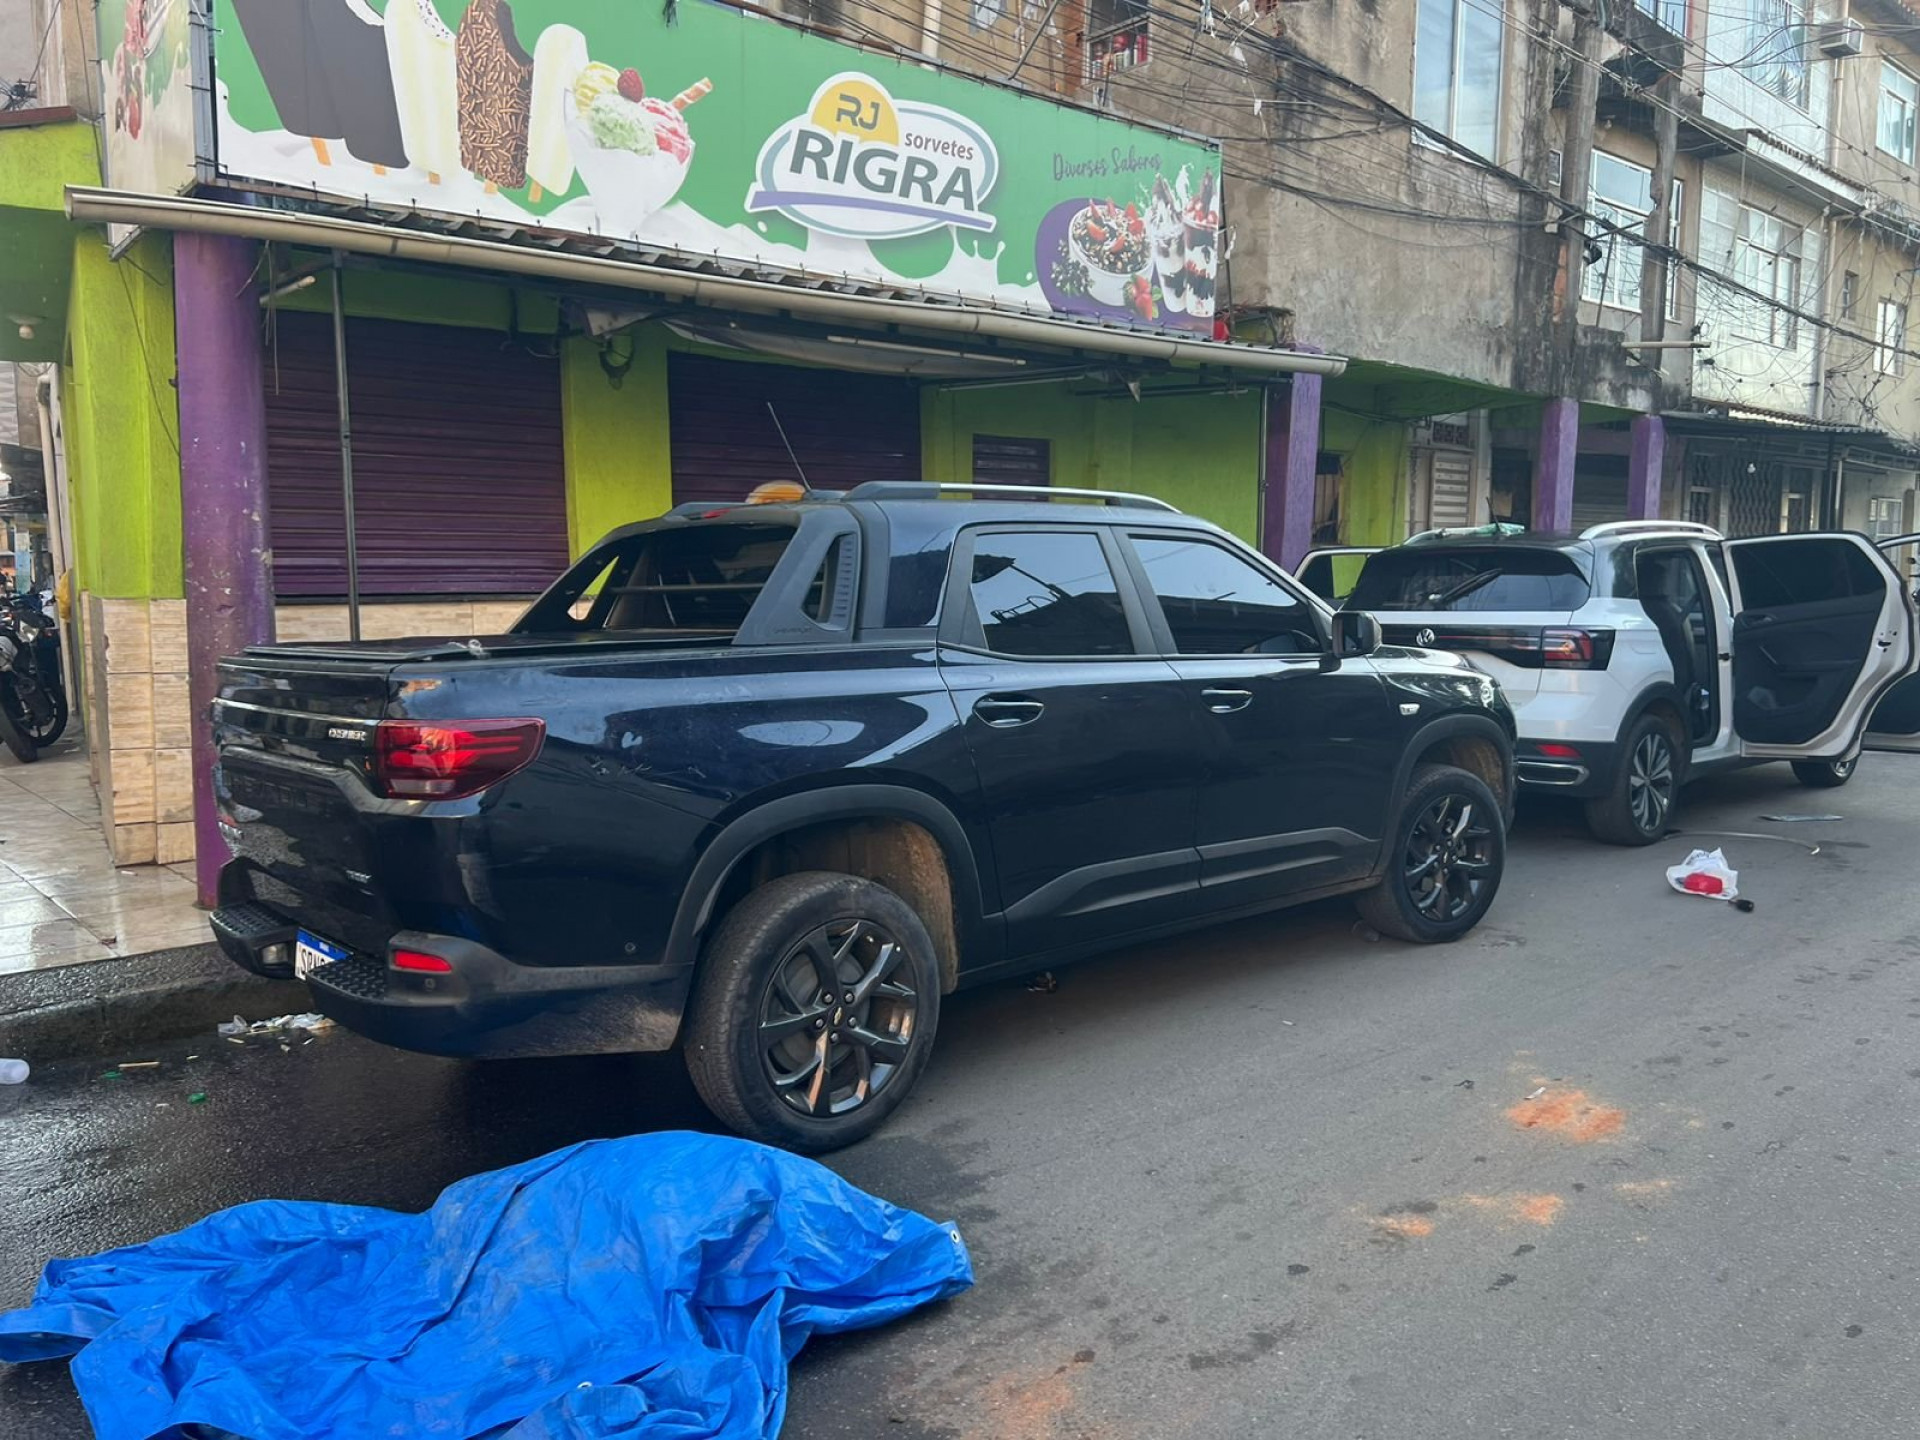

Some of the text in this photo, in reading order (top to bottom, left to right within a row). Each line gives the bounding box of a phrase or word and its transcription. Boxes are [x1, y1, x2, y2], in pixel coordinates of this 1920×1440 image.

[834, 93, 881, 131] RJ
[904, 131, 974, 161] sorvetes
[1053, 145, 1162, 181] Diversos Sabores
[789, 129, 976, 212] RIGRA
